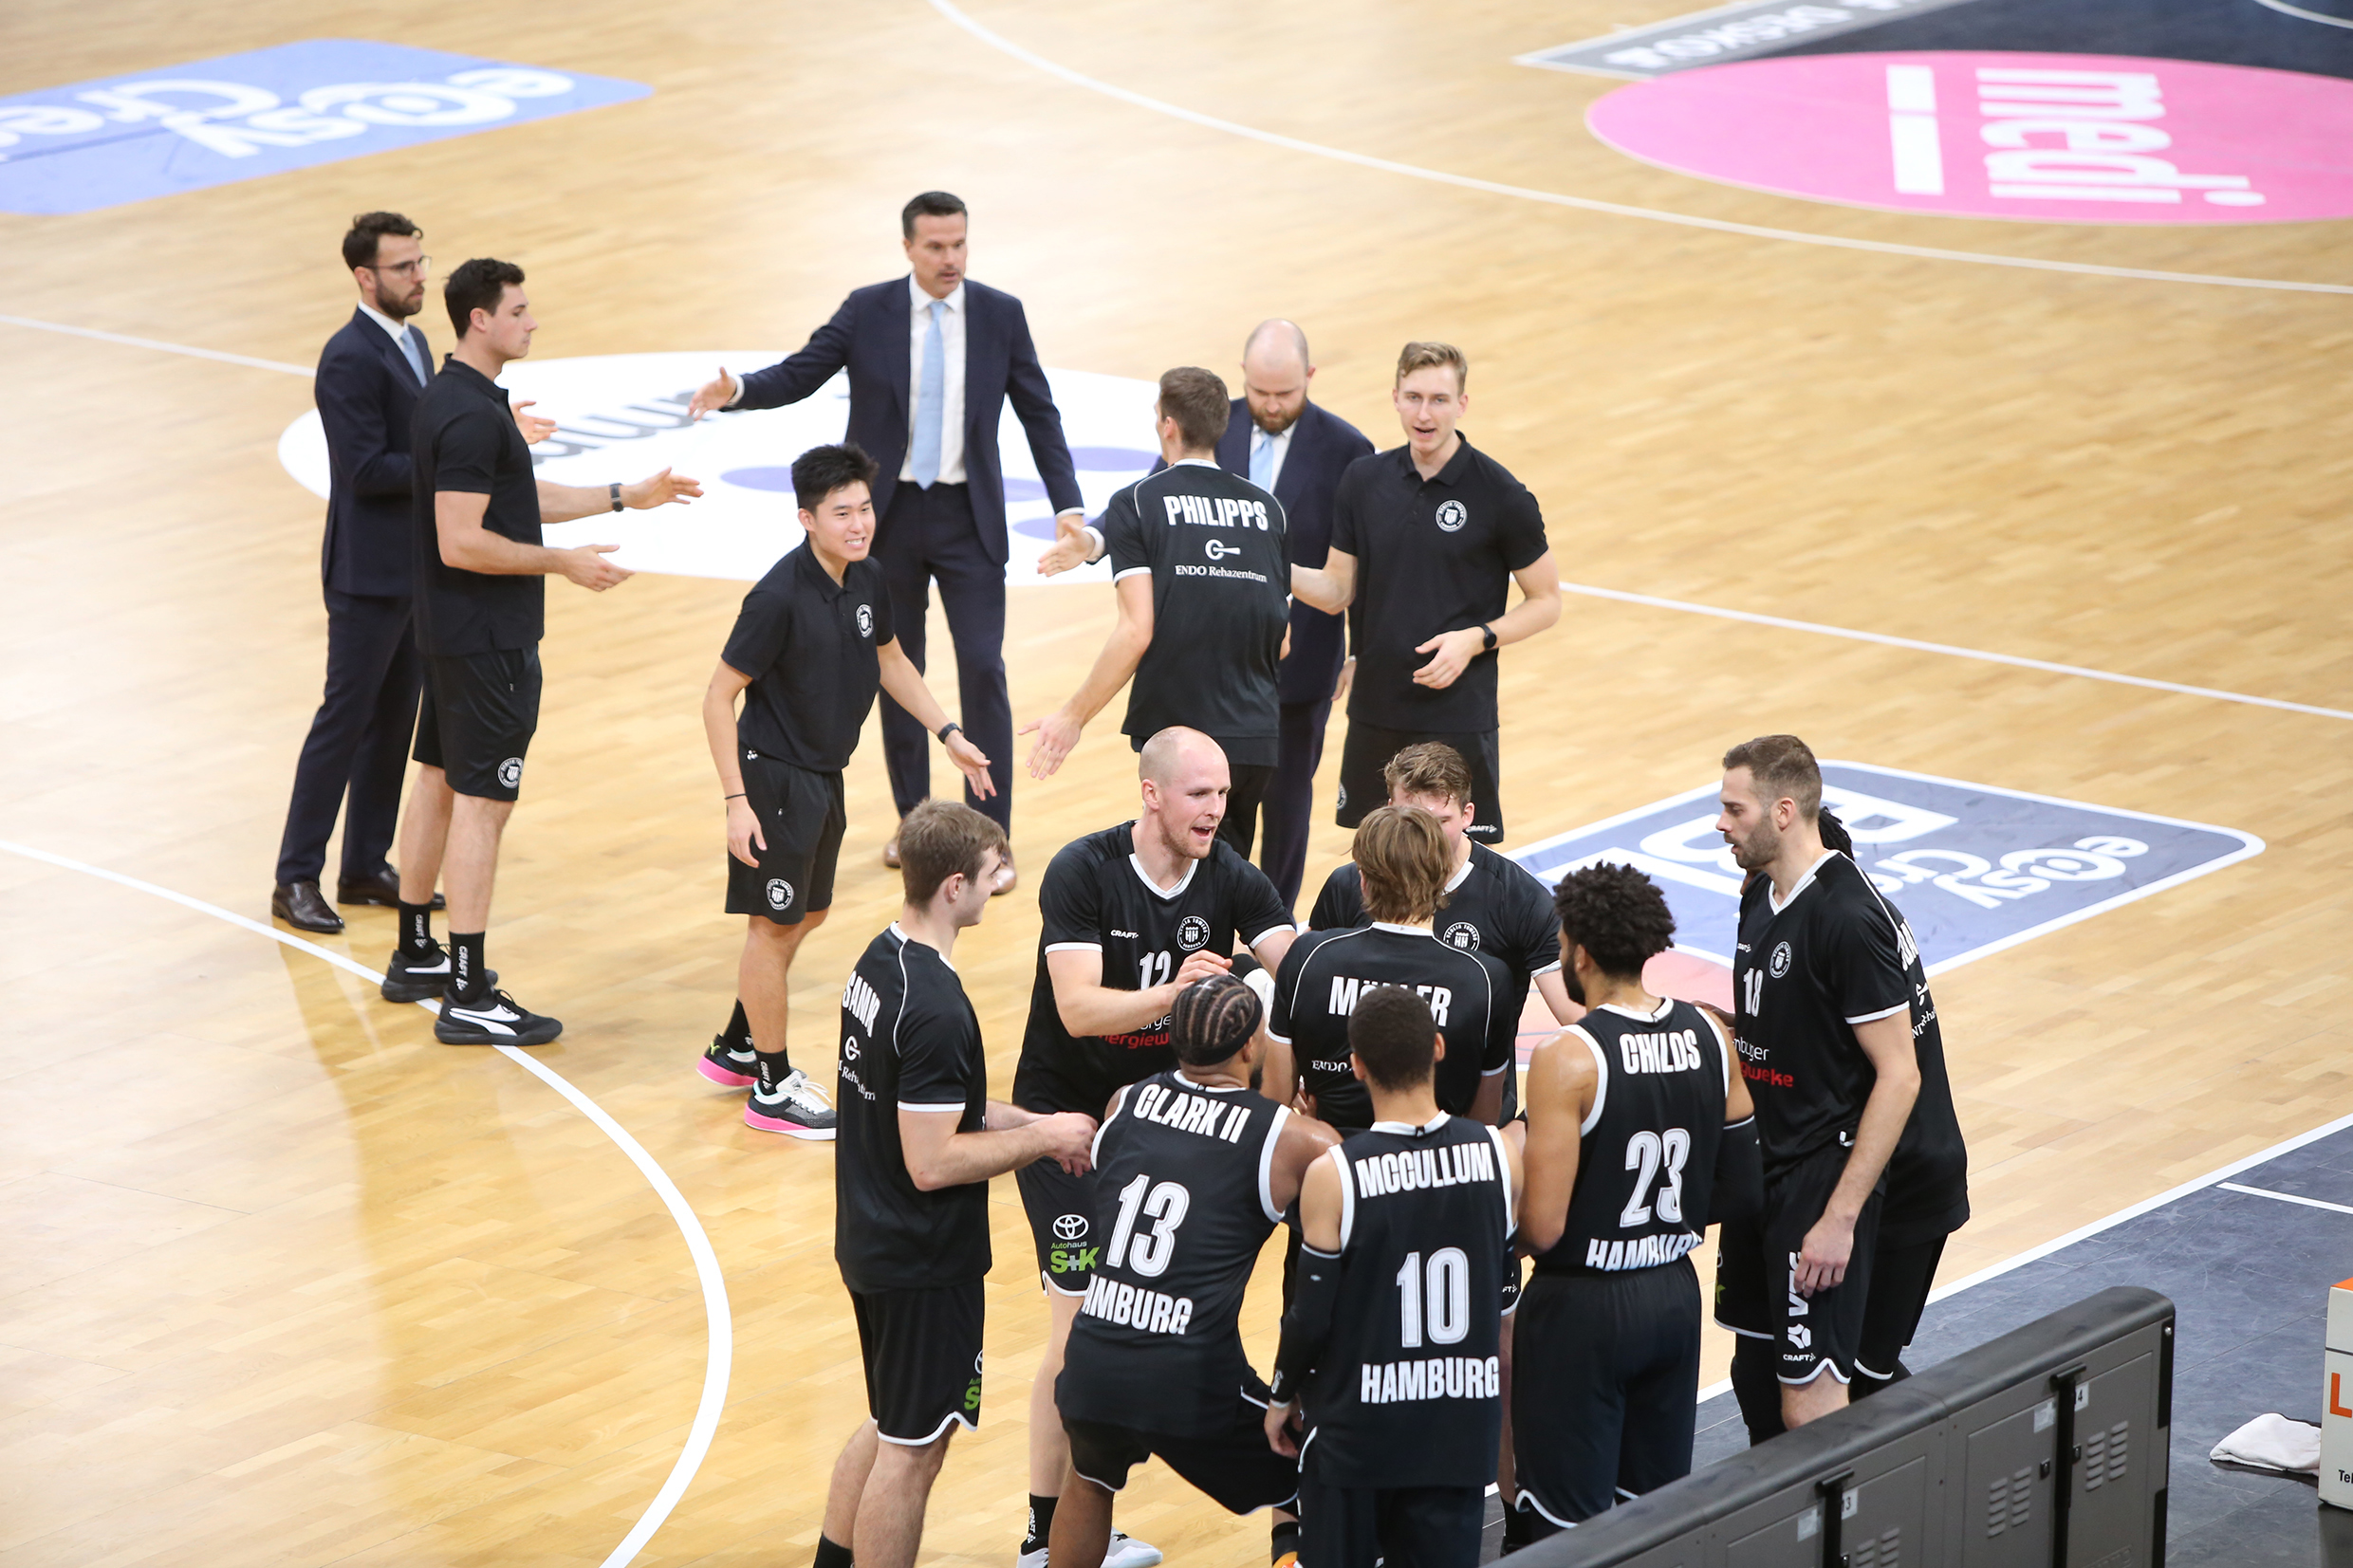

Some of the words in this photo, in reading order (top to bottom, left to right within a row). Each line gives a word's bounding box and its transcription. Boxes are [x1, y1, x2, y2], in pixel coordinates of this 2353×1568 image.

[1975, 66, 2267, 207] medi
[1162, 494, 1269, 531] PHILIPPS
[1175, 564, 1207, 577] ENDO
[1209, 565, 1268, 583] Rehazentrum
[1110, 930, 1135, 939] CRAFT
[457, 946, 470, 978] CRAFT
[1139, 950, 1172, 992] 12
[1743, 968, 1764, 1017] 18
[1619, 1028, 1701, 1075] CHILDS
[1133, 1083, 1227, 1136] CLARK
[1219, 1104, 1251, 1144] II
[1355, 1142, 1495, 1199] MCCULLUM
[1619, 1128, 1691, 1227] 23
[1050, 1241, 1087, 1249] Autohaus
[1105, 1173, 1190, 1277] 13
[1050, 1246, 1101, 1274] S+K
[1396, 1246, 1470, 1348] 10
[1360, 1356, 1500, 1404] HAMBURG
[1783, 1354, 1810, 1362] CRAFT
